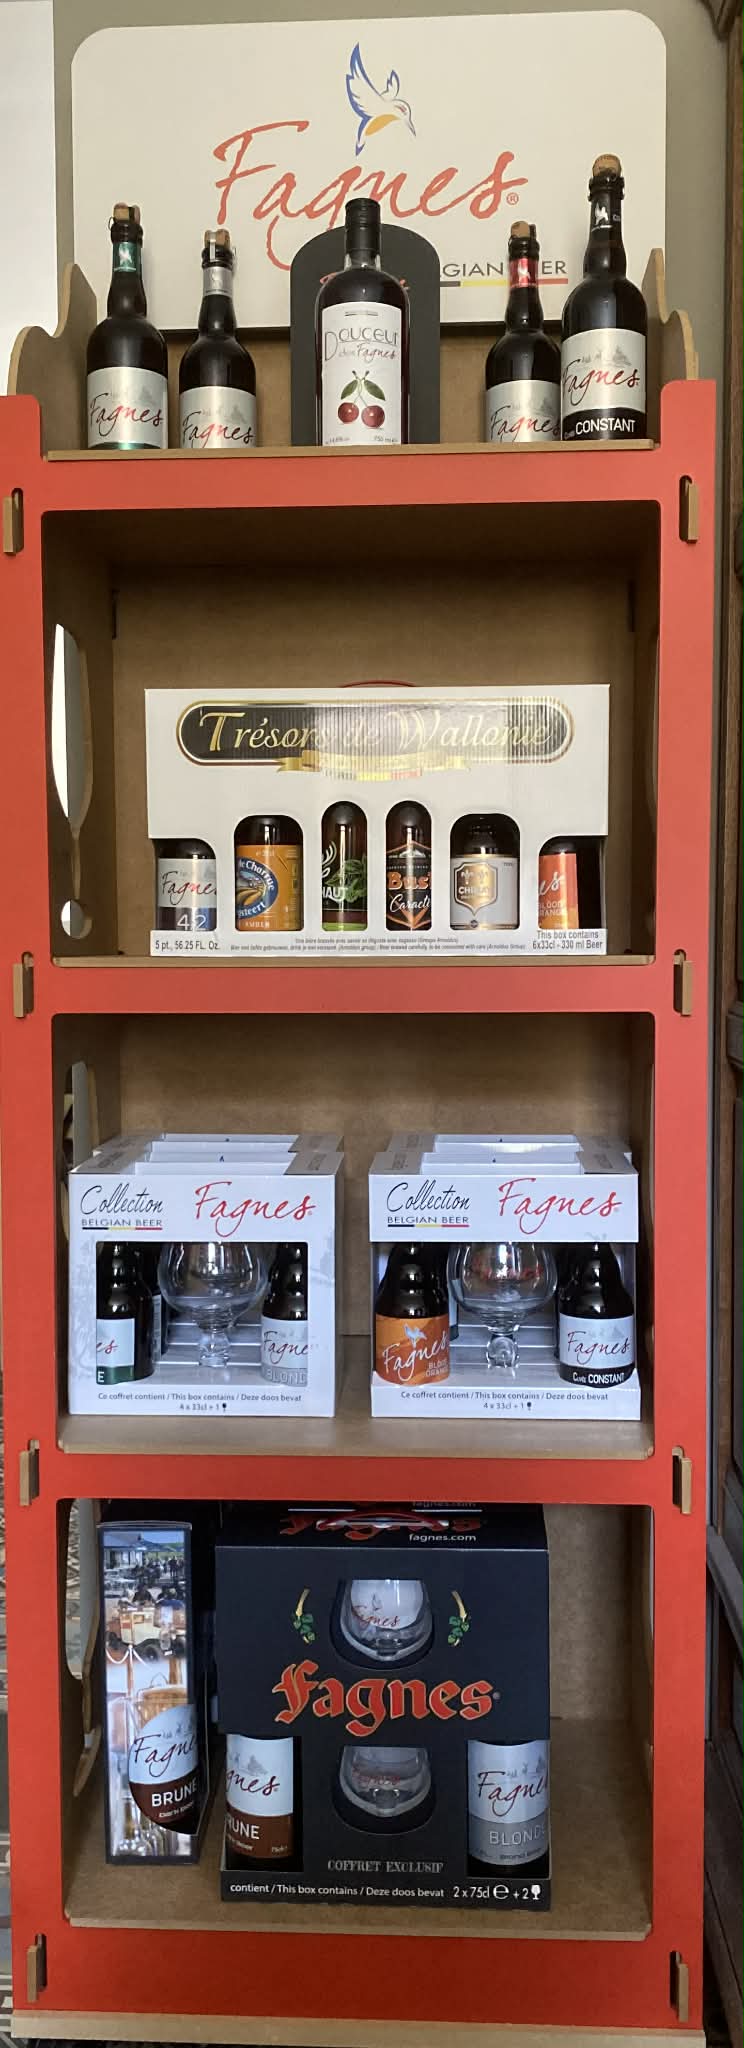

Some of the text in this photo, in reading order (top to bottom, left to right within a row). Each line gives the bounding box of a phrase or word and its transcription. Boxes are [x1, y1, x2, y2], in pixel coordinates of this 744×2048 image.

[212, 120, 529, 271] Fagnes
[440, 260, 567, 278] GIAN ER
[357, 342, 397, 364] Fagnes
[562, 359, 641, 406] Fagnes
[90, 392, 164, 437] Fagnes
[575, 417, 636, 435] CONSTANT
[183, 411, 255, 449] Fagnes
[200, 708, 332, 752] Trésors
[385, 709, 551, 751] Wallonie
[155, 940, 160, 950] 5
[532, 939, 556, 950] 6x33cl
[561, 939, 574, 950] 330
[575, 939, 585, 950] ml
[586, 938, 604, 949] Beer
[537, 930, 599, 939] This box contains
[80, 1183, 164, 1215] Collection
[386, 1179, 471, 1213] Collection
[498, 1178, 623, 1235] Fagnes
[194, 1181, 316, 1238] Fagnes
[387, 1216, 469, 1224] BELGIAN BEER
[81, 1218, 163, 1227] BELGIAN BEER
[263, 1330, 308, 1365] Fagne
[382, 1329, 448, 1382] Fagnes
[567, 1330, 631, 1365] Fagnes
[587, 1372, 625, 1385] CONSTANT
[109, 1391, 133, 1400] coffret
[134, 1391, 166, 1401] contient
[172, 1393, 186, 1401] This
[187, 1393, 201, 1401] box
[203, 1393, 235, 1402] contains
[240, 1393, 260, 1401] Deze
[260, 1393, 279, 1402] doos
[280, 1394, 302, 1402] bevat
[400, 1391, 411, 1399] Ce
[411, 1391, 437, 1400] coffret
[438, 1391, 470, 1400] contient
[475, 1391, 491, 1400] This
[492, 1391, 507, 1400] box
[507, 1391, 541, 1401] contains
[545, 1392, 566, 1401] Deze
[566, 1392, 586, 1401] doos
[586, 1392, 609, 1402] bevat
[483, 1401, 489, 1409] 4
[495, 1402, 512, 1410] 33cl
[408, 1533, 477, 1542] fagnes.com
[271, 1659, 494, 1737] Fagnes
[151, 1777, 197, 1807] BRUNE
[226, 1769, 280, 1796] gnes
[225, 1813, 260, 1840] RUNE
[327, 1859, 444, 1874] COFFRET EXCLUSIF
[230, 1883, 270, 1893] contient
[277, 1884, 297, 1894] This
[299, 1885, 316, 1895] box
[317, 1886, 358, 1896] contains
[366, 1887, 390, 1896] Deze
[391, 1887, 415, 1897] doos
[417, 1887, 444, 1898] bevat
[452, 1886, 460, 1898] 2
[461, 1889, 468, 1898] x
[469, 1885, 490, 1899] 75cl
[522, 1887, 529, 1900] 2
